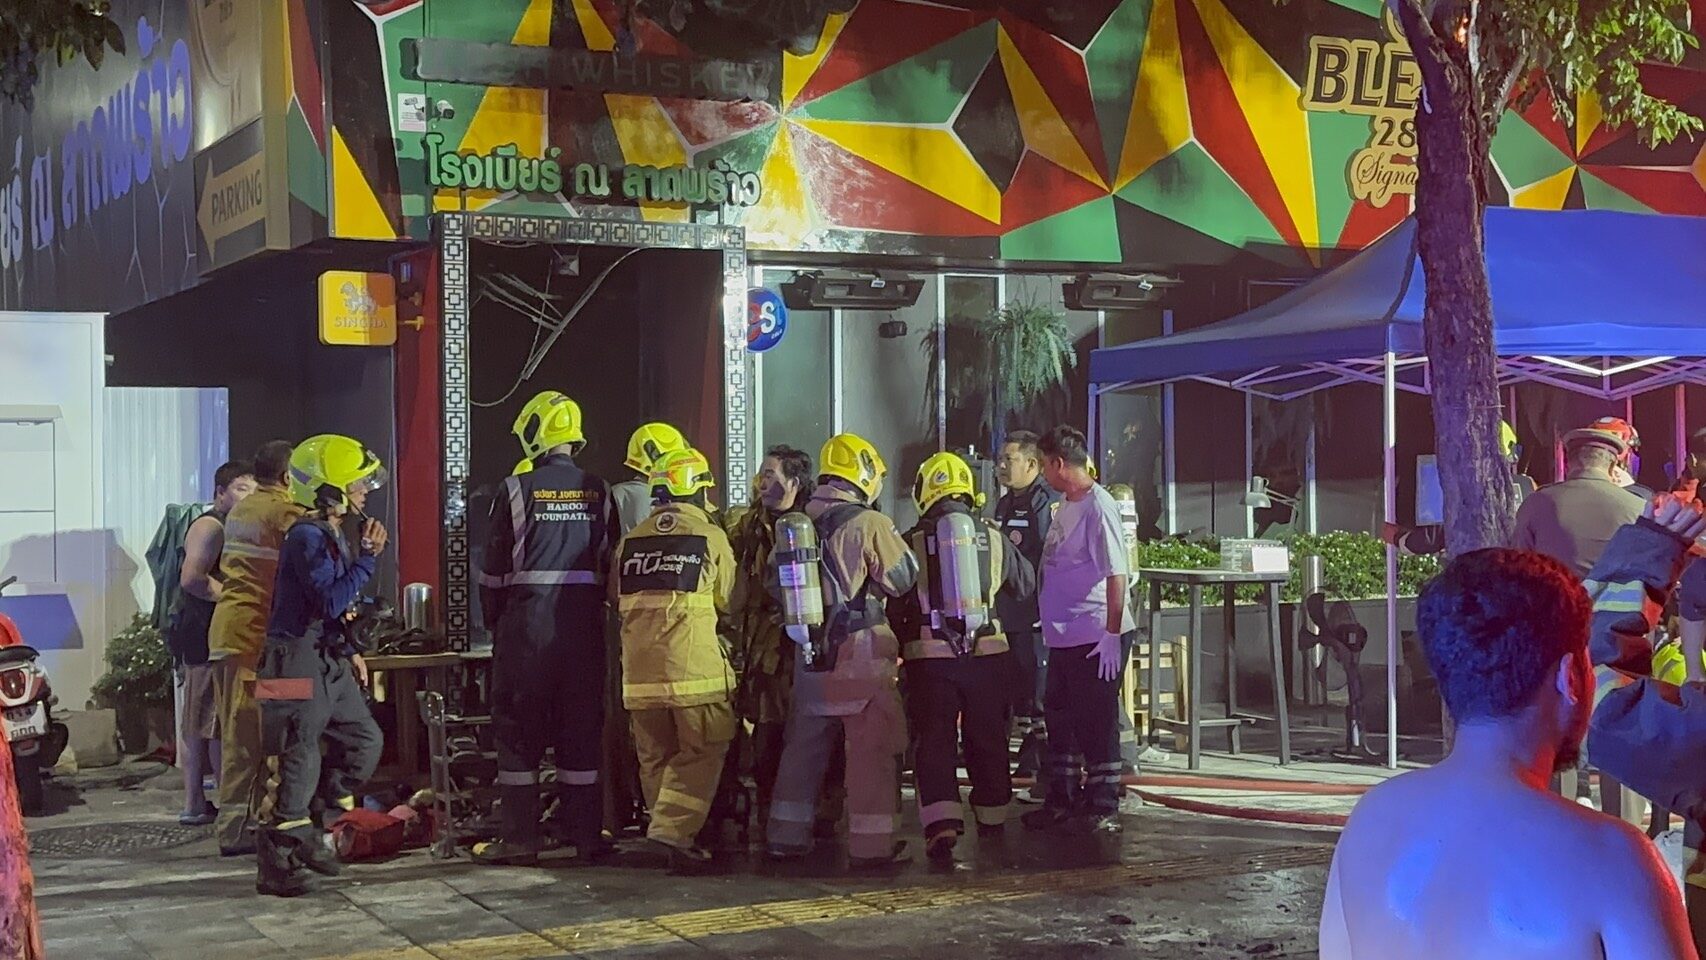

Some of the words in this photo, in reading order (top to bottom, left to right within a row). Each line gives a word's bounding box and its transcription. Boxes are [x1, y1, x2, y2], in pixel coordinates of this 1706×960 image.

[1312, 44, 1418, 110] BLE
[1378, 118, 1417, 149] 28
[427, 133, 562, 193] โรงเบียร์
[575, 161, 611, 197] ณ
[622, 159, 762, 206] ลาดพร้าว
[1355, 153, 1418, 200] Signa
[211, 169, 263, 227] PARKING
[334, 314, 387, 328] SINGHA
[534, 512, 598, 521] FOUNDATIN
